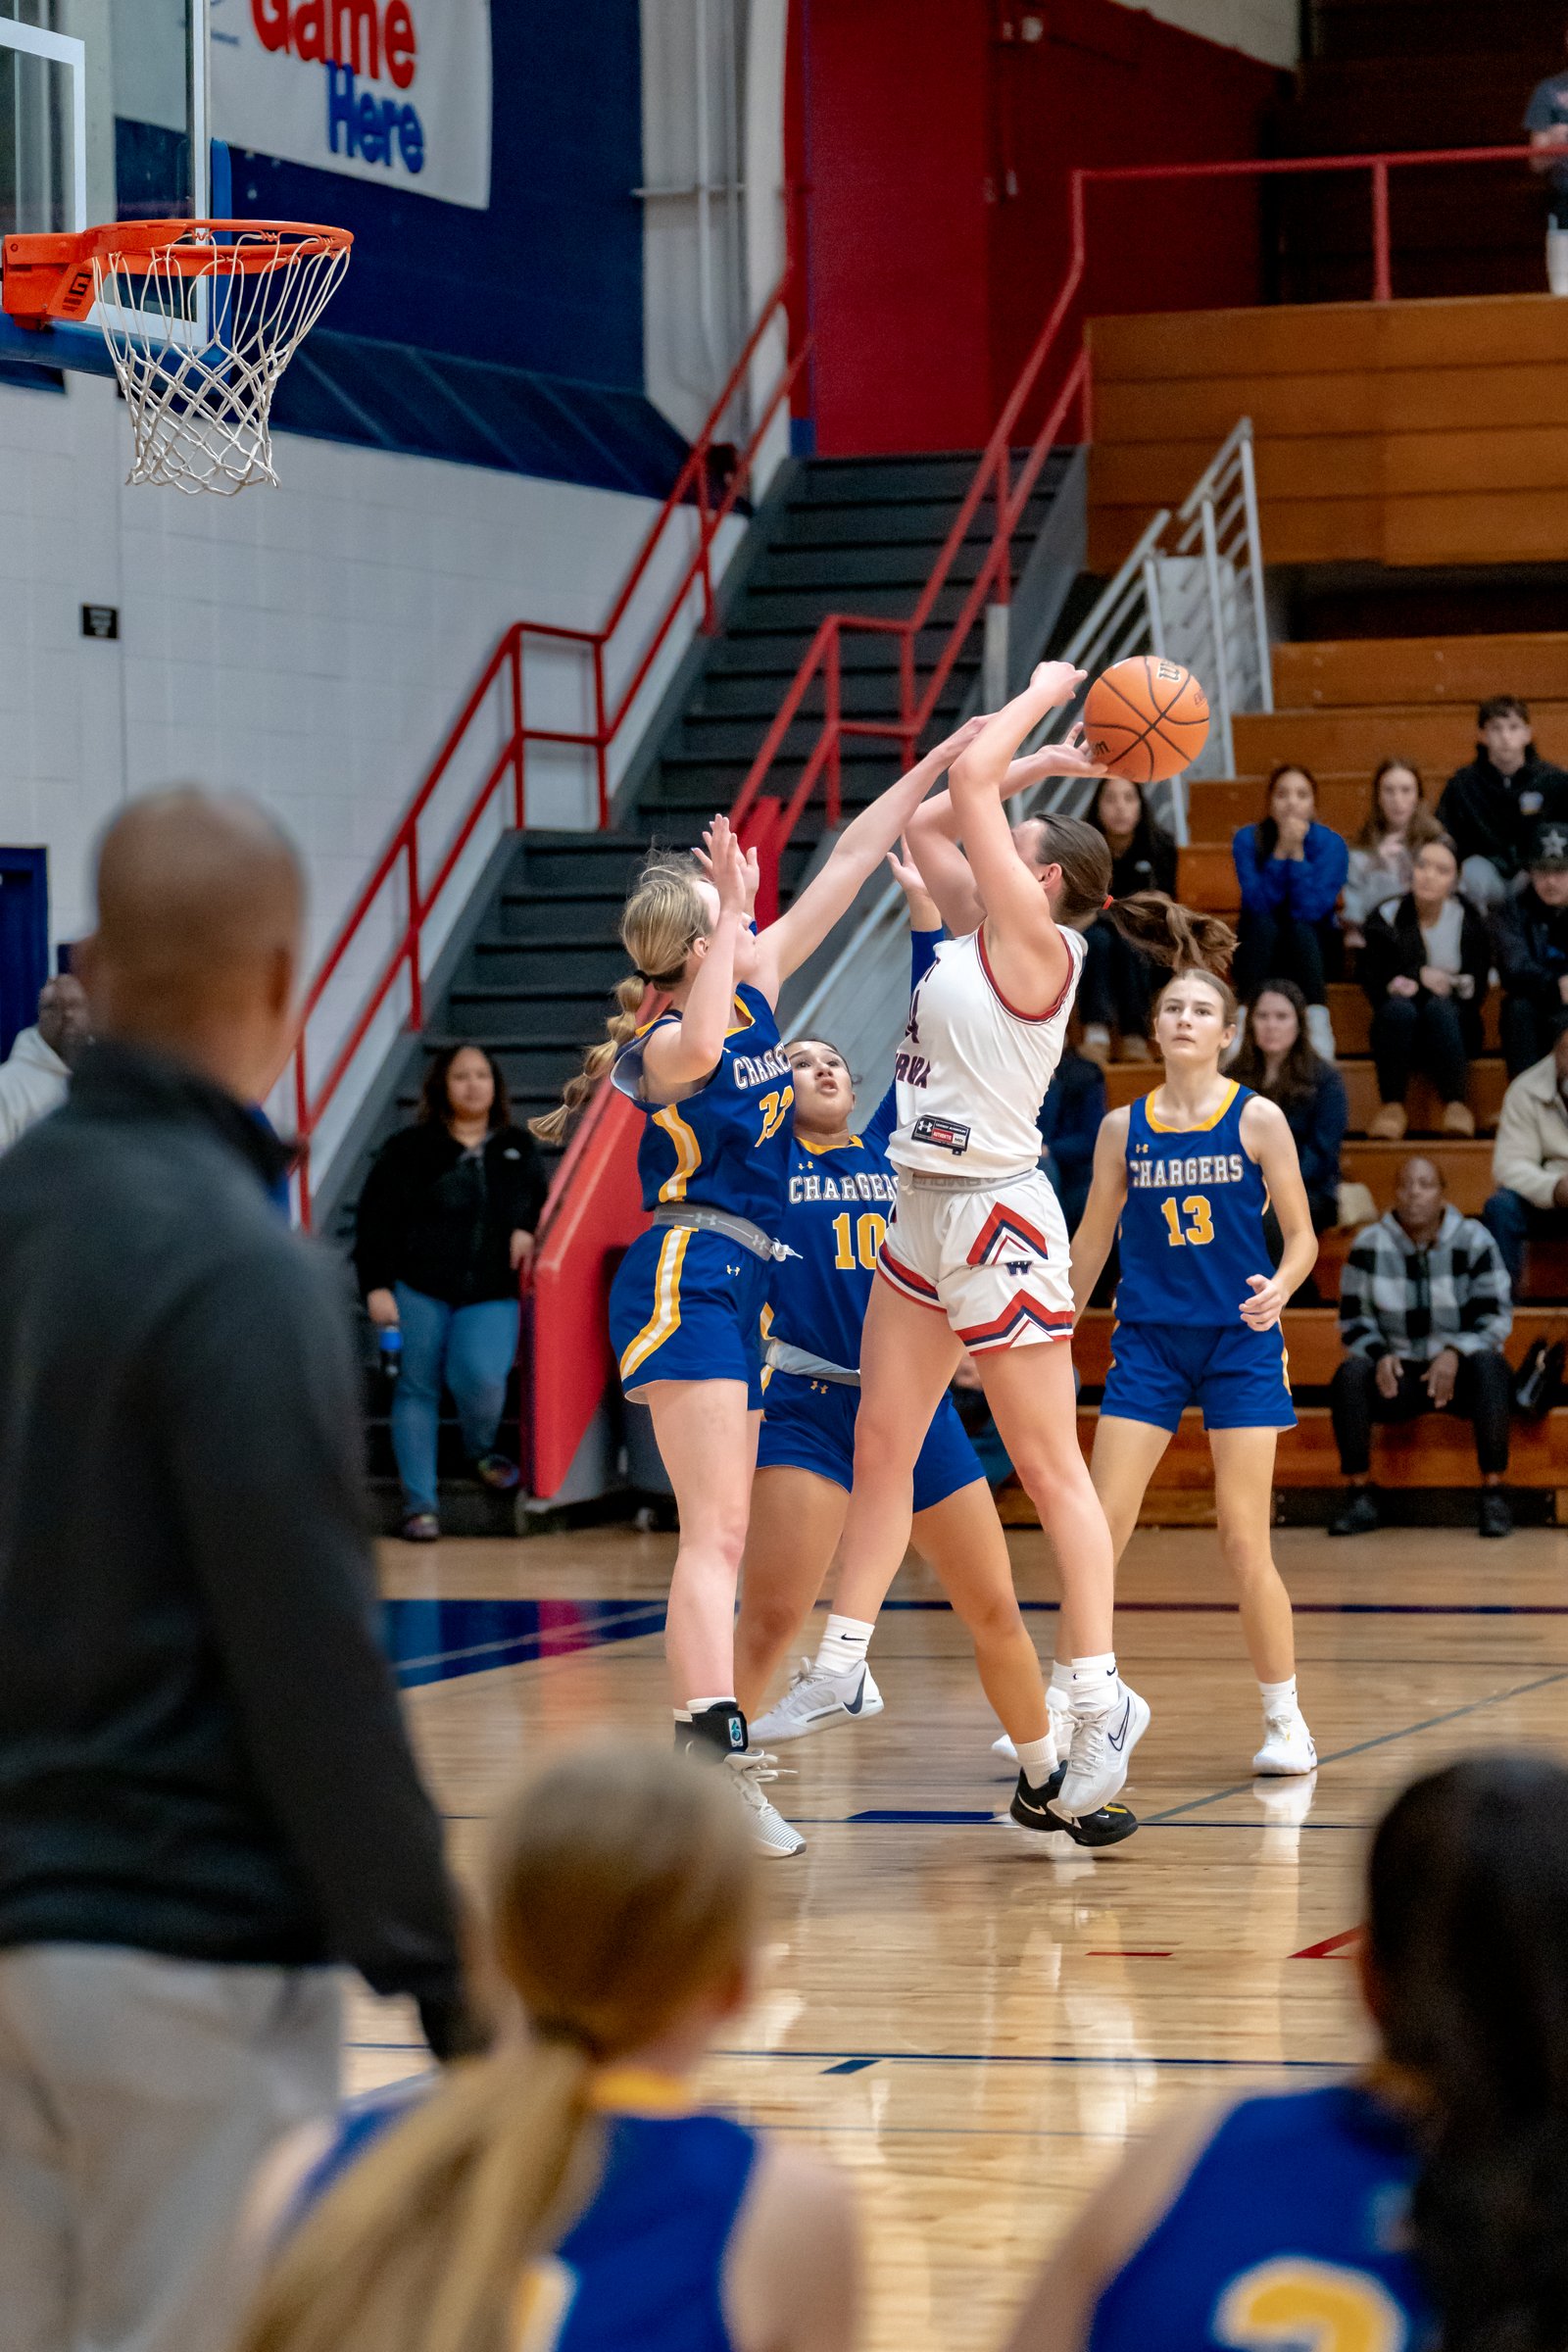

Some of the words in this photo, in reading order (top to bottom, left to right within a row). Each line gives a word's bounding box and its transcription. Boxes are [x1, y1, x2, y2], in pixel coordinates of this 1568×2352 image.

[326, 60, 423, 173] Here
[733, 1042, 792, 1090] CHARG
[832, 1212, 887, 1270] 10
[1160, 1195, 1215, 1247] 13
